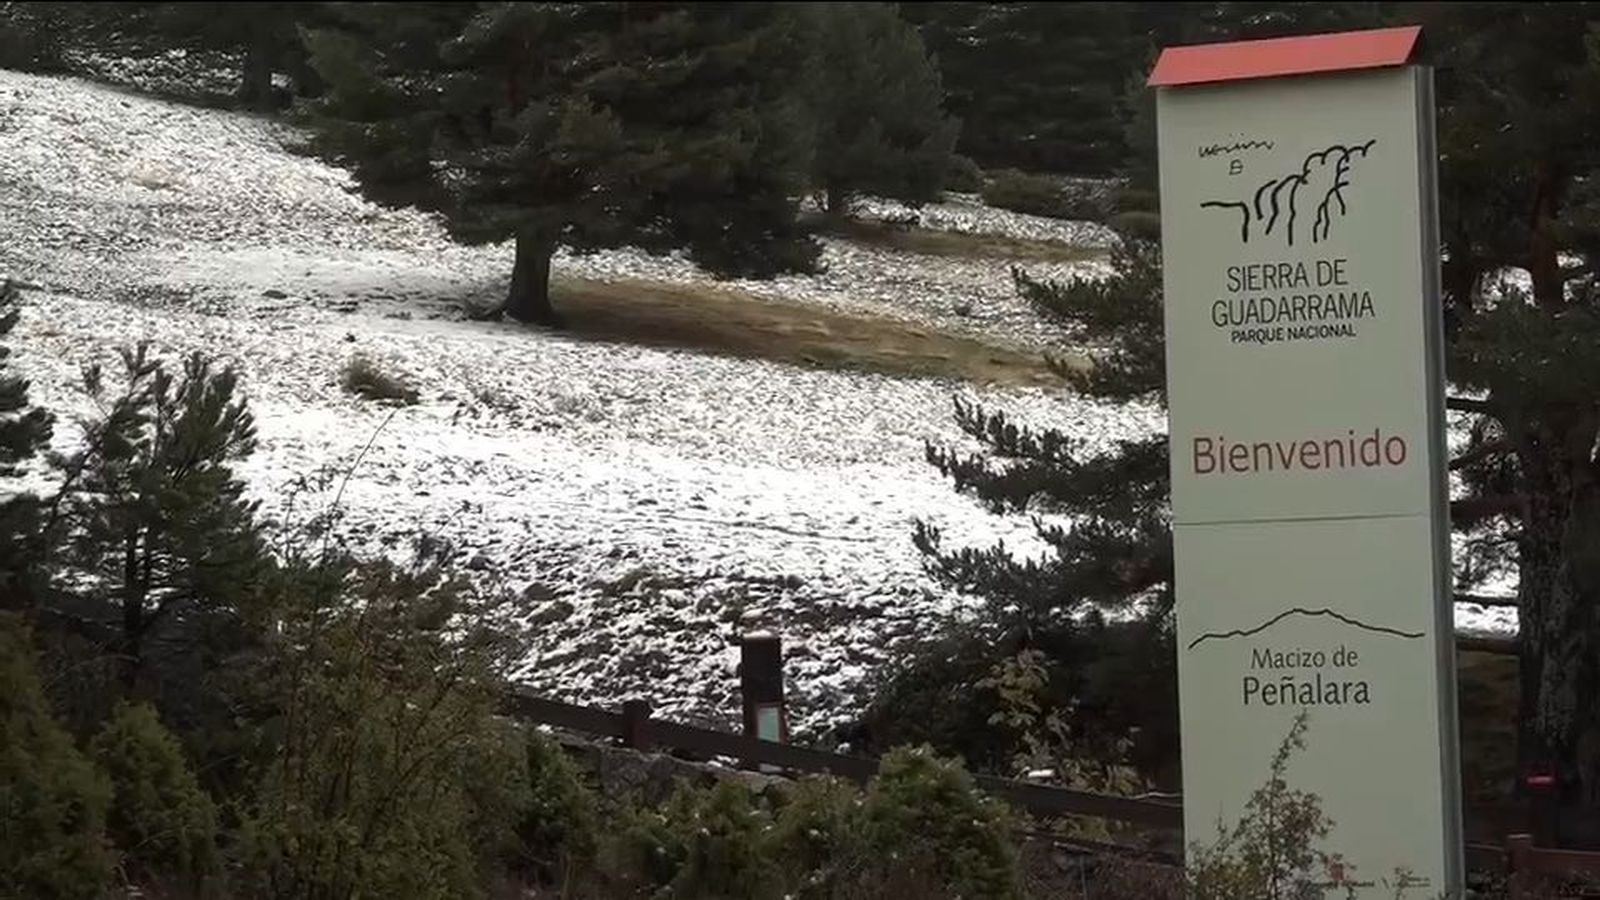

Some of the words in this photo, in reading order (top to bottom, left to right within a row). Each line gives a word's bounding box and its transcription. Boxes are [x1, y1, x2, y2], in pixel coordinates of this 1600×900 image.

[1226, 262, 1310, 293] SIERRA
[1316, 259, 1349, 287] DE
[1211, 291, 1376, 328] GUADARRAMA
[1231, 327, 1285, 345] PARQUE
[1287, 323, 1357, 341] NACIONAL
[1192, 428, 1407, 474] Bienvenido
[1251, 647, 1326, 669] Macizo
[1332, 644, 1359, 667] de
[1243, 673, 1371, 706] Peñalara
